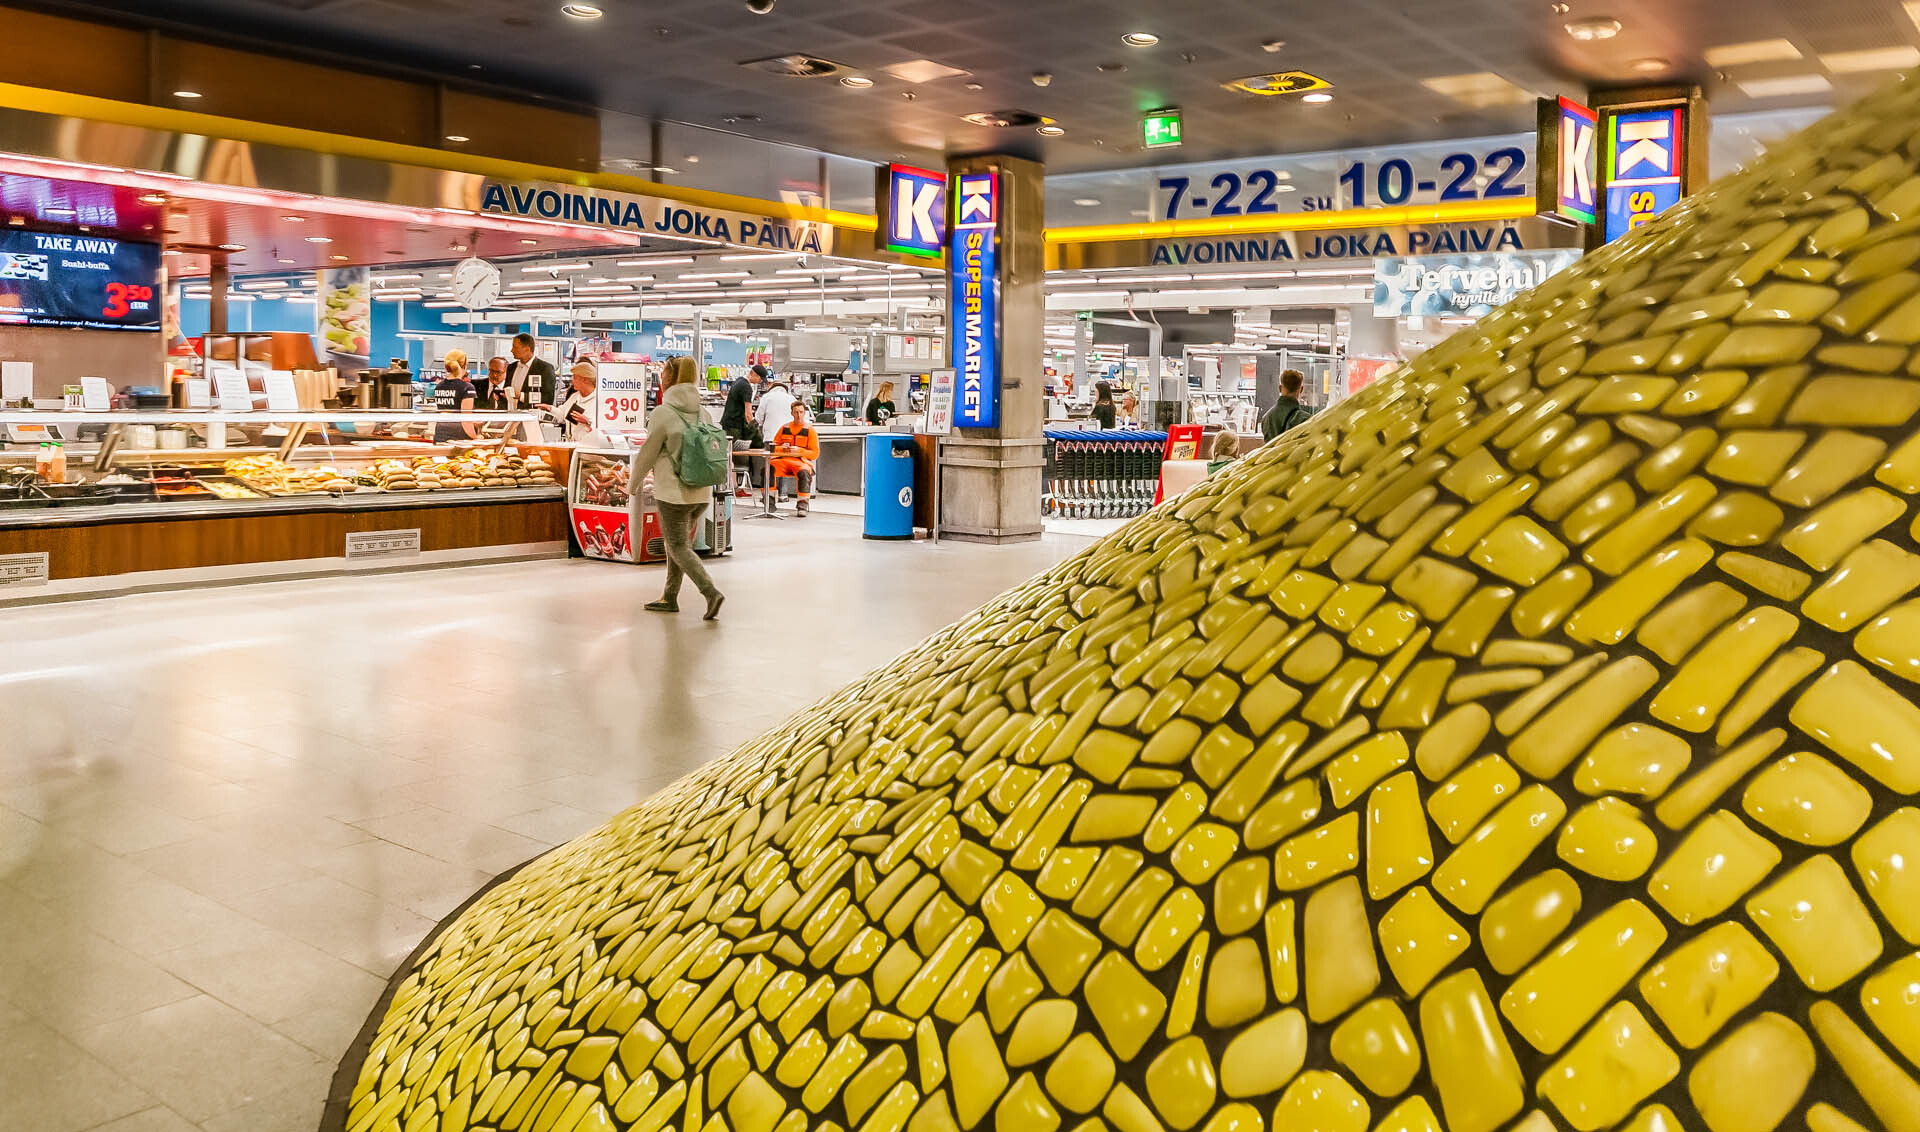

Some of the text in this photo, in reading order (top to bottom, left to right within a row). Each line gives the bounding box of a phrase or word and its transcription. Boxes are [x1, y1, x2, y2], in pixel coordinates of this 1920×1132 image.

[1563, 116, 1594, 206] K
[1619, 119, 1670, 176] K
[962, 180, 991, 221] K
[1159, 147, 1526, 220] 7-22 su 10-22
[482, 184, 823, 253] AVOINNA JOKA PÄIVÄ
[897, 178, 941, 244] K
[35, 236, 118, 255] TAKE AWAY
[1152, 220, 1525, 265] AVOINNA JOKA PÄIVÄ
[1401, 259, 1556, 292] Tervetul
[963, 232, 983, 422] SUPERMARKET
[601, 377, 642, 390] Smoothie
[625, 415, 637, 424] kpl
